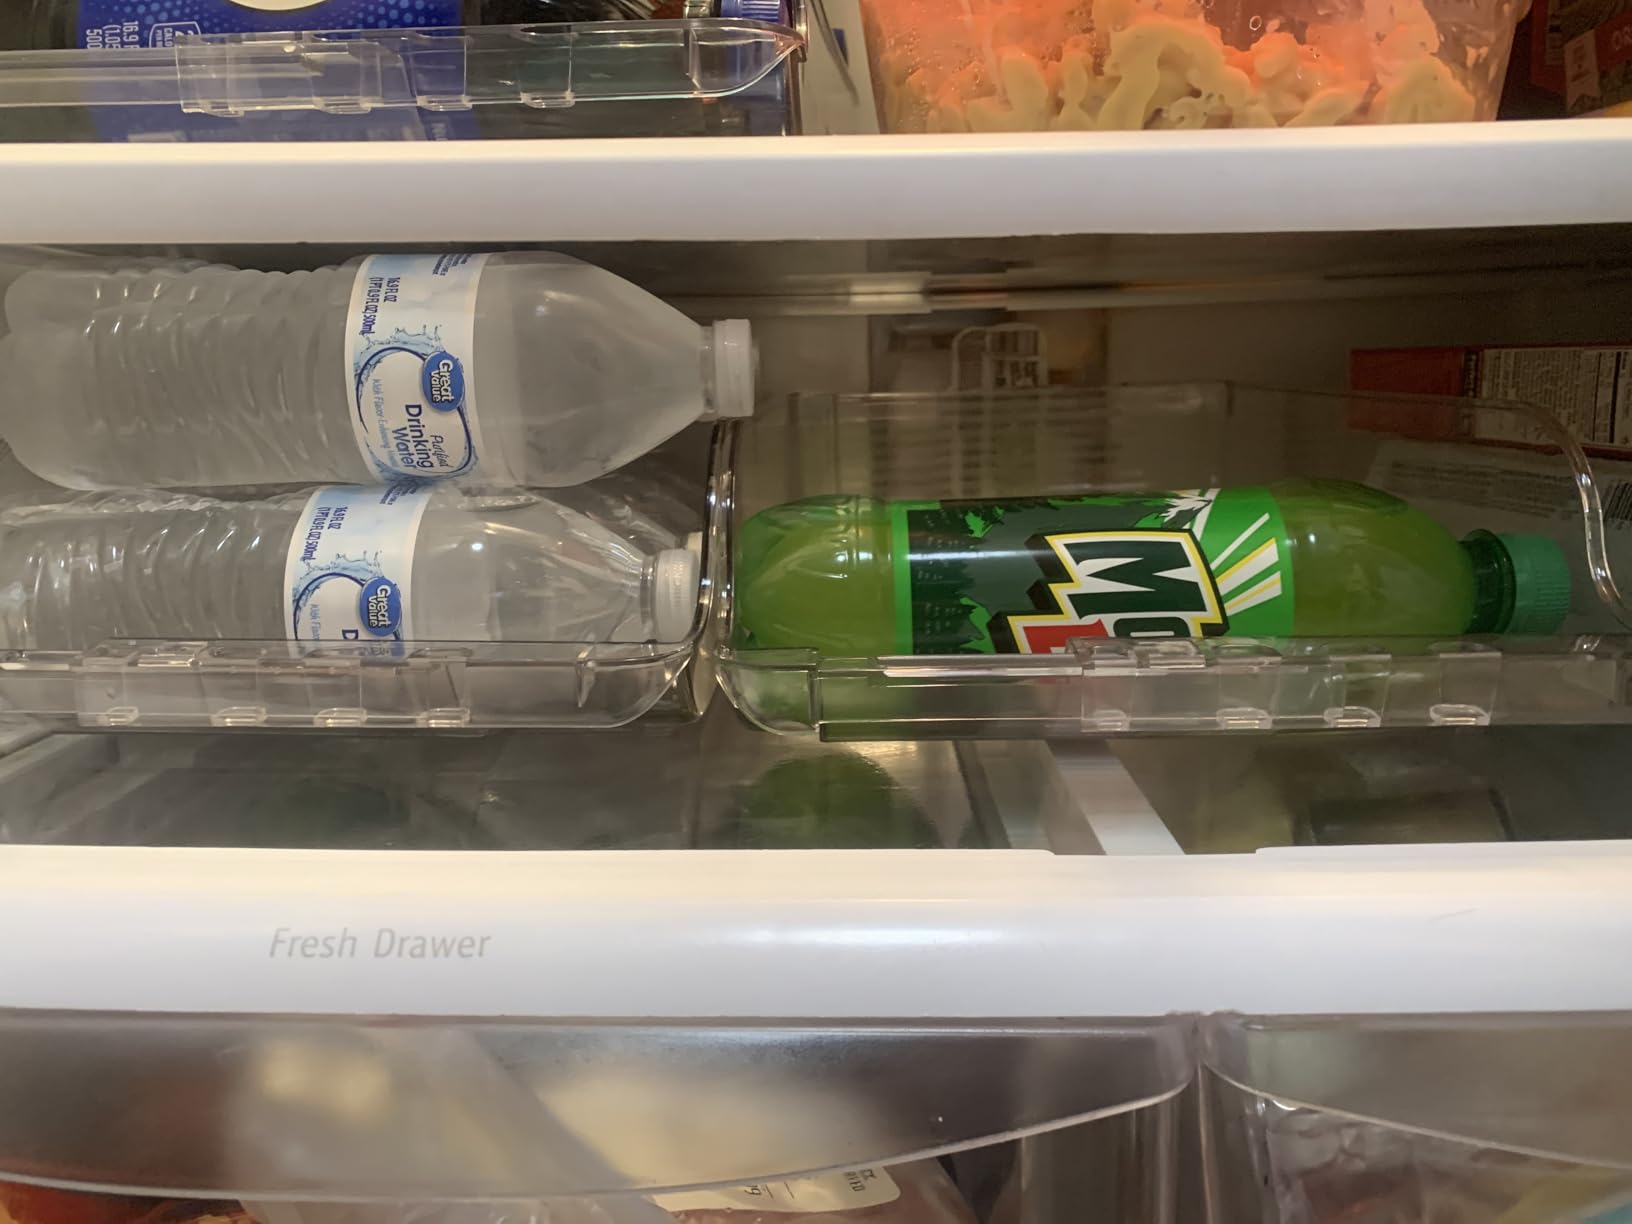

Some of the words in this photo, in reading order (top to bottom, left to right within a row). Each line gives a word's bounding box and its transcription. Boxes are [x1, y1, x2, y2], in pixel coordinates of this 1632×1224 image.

[123, 20, 139, 42] 16.9
[430, 370, 441, 403] Value
[439, 359, 455, 403] Great
[392, 427, 416, 468] Water
[405, 404, 434, 469] Drinking
[430, 434, 454, 468] Purified
[368, 595, 378, 628] Value
[376, 584, 392, 627] Great
[269, 927, 358, 959] Fresh
[373, 927, 493, 959] Drawer
